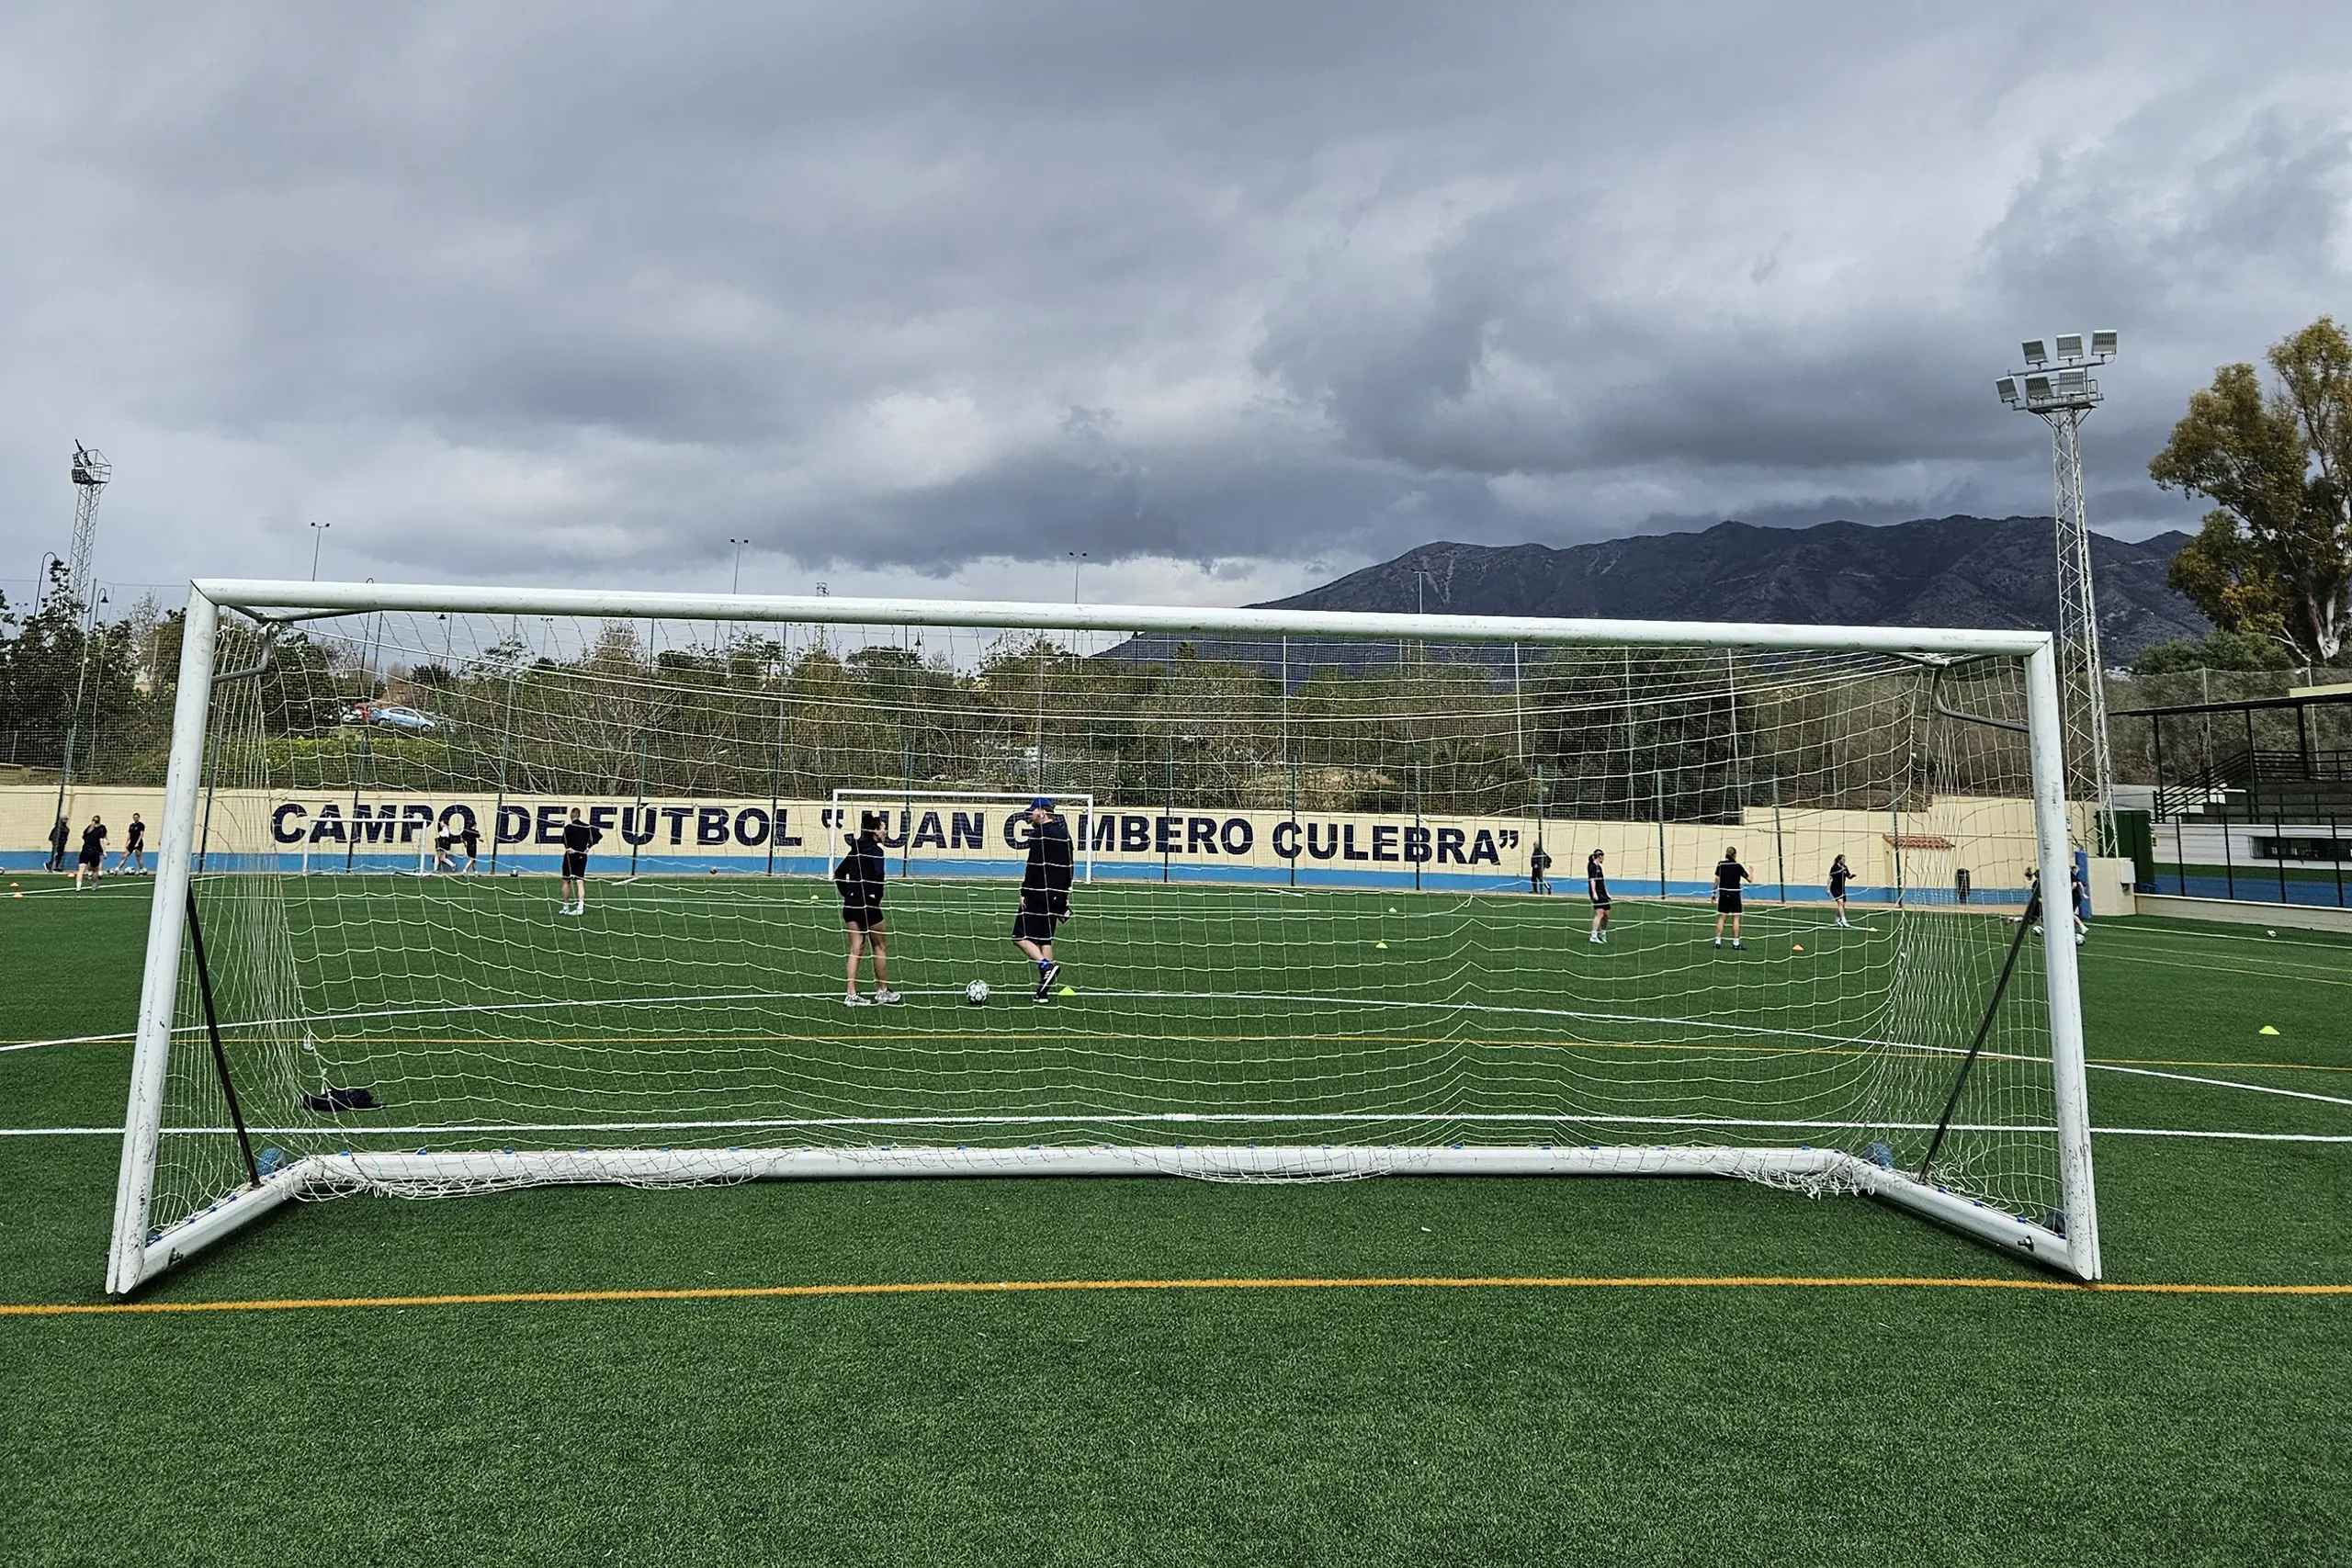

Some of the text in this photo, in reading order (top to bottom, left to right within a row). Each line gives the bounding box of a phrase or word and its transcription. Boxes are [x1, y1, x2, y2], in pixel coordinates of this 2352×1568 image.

[271, 803, 476, 844] CAMPO
[496, 805, 568, 845] DE
[587, 805, 803, 847] FUTBOL
[1003, 811, 1254, 855] GMBERO
[1272, 820, 1519, 866] CULEBRA”
